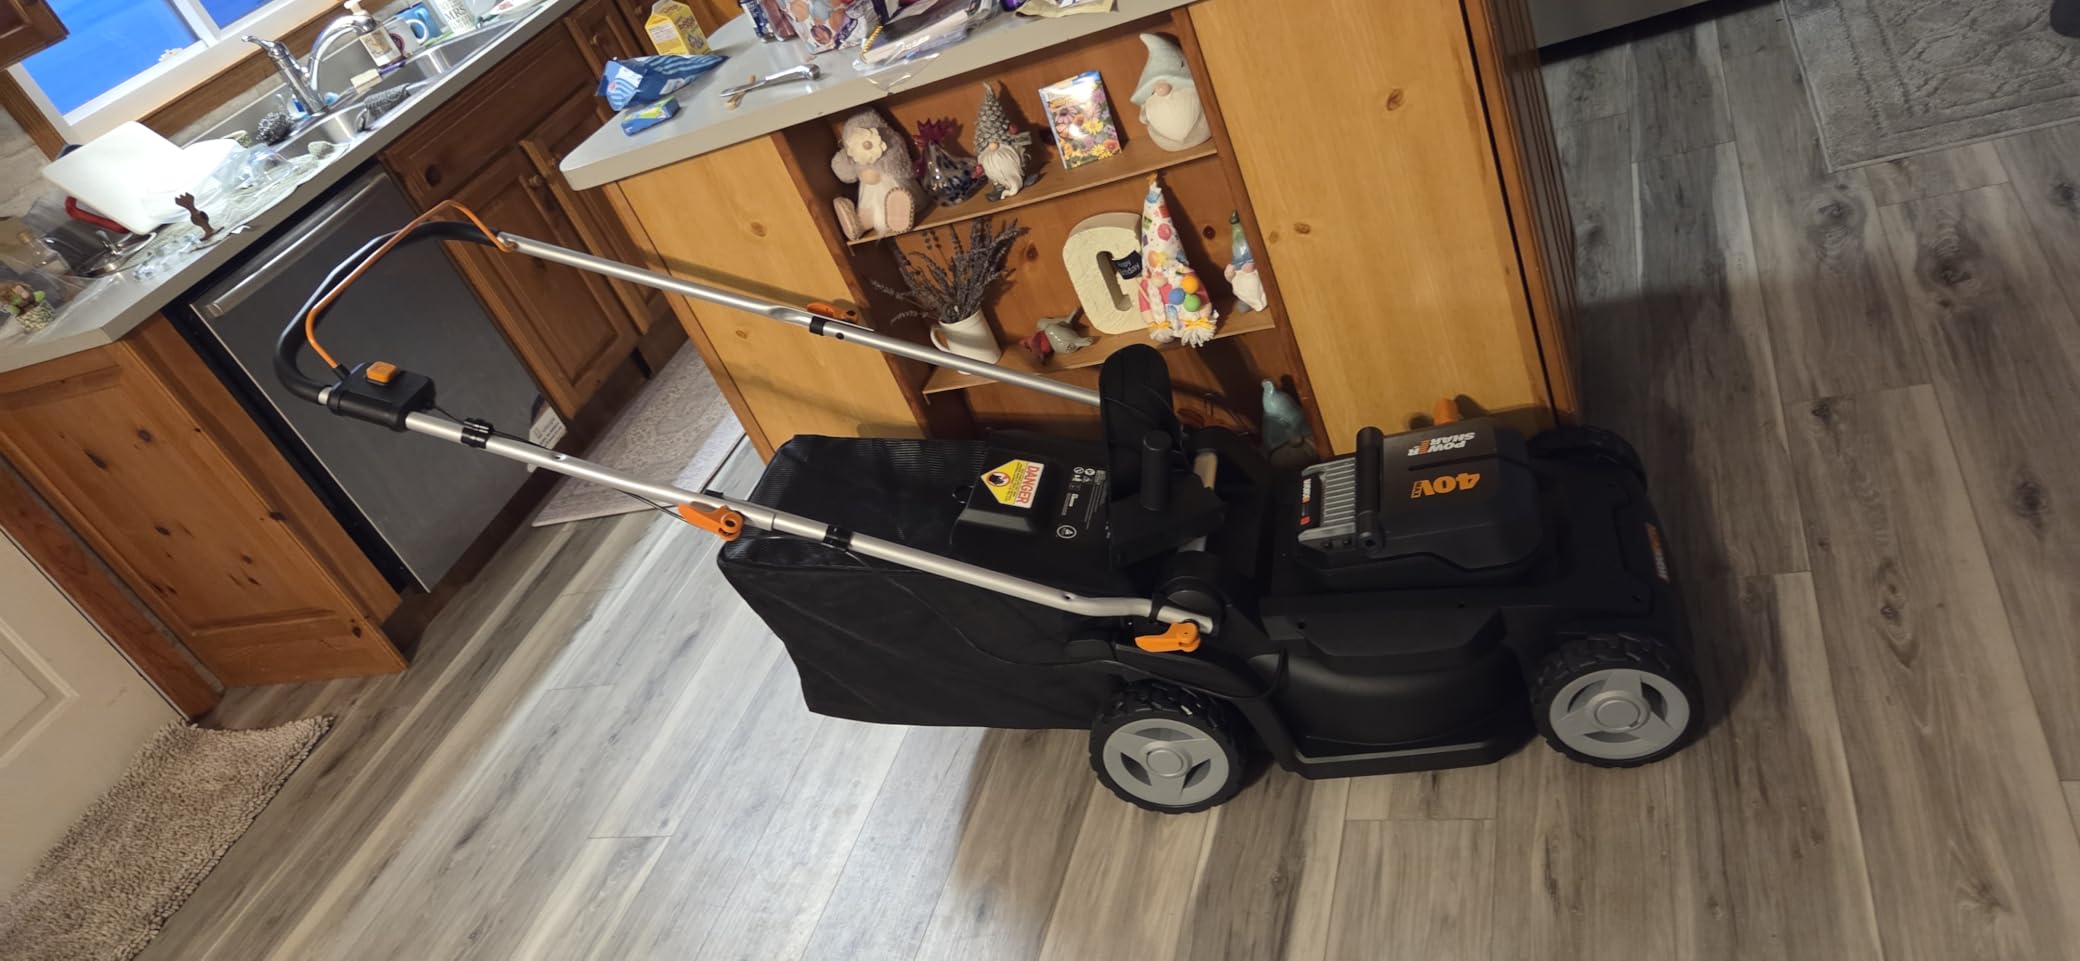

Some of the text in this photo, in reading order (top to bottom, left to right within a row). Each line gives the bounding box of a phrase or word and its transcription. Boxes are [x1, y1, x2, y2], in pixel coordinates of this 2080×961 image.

[1407, 440, 1467, 456] POWER
[1016, 465, 1041, 504] DANGER
[1416, 472, 1481, 496] 40V
